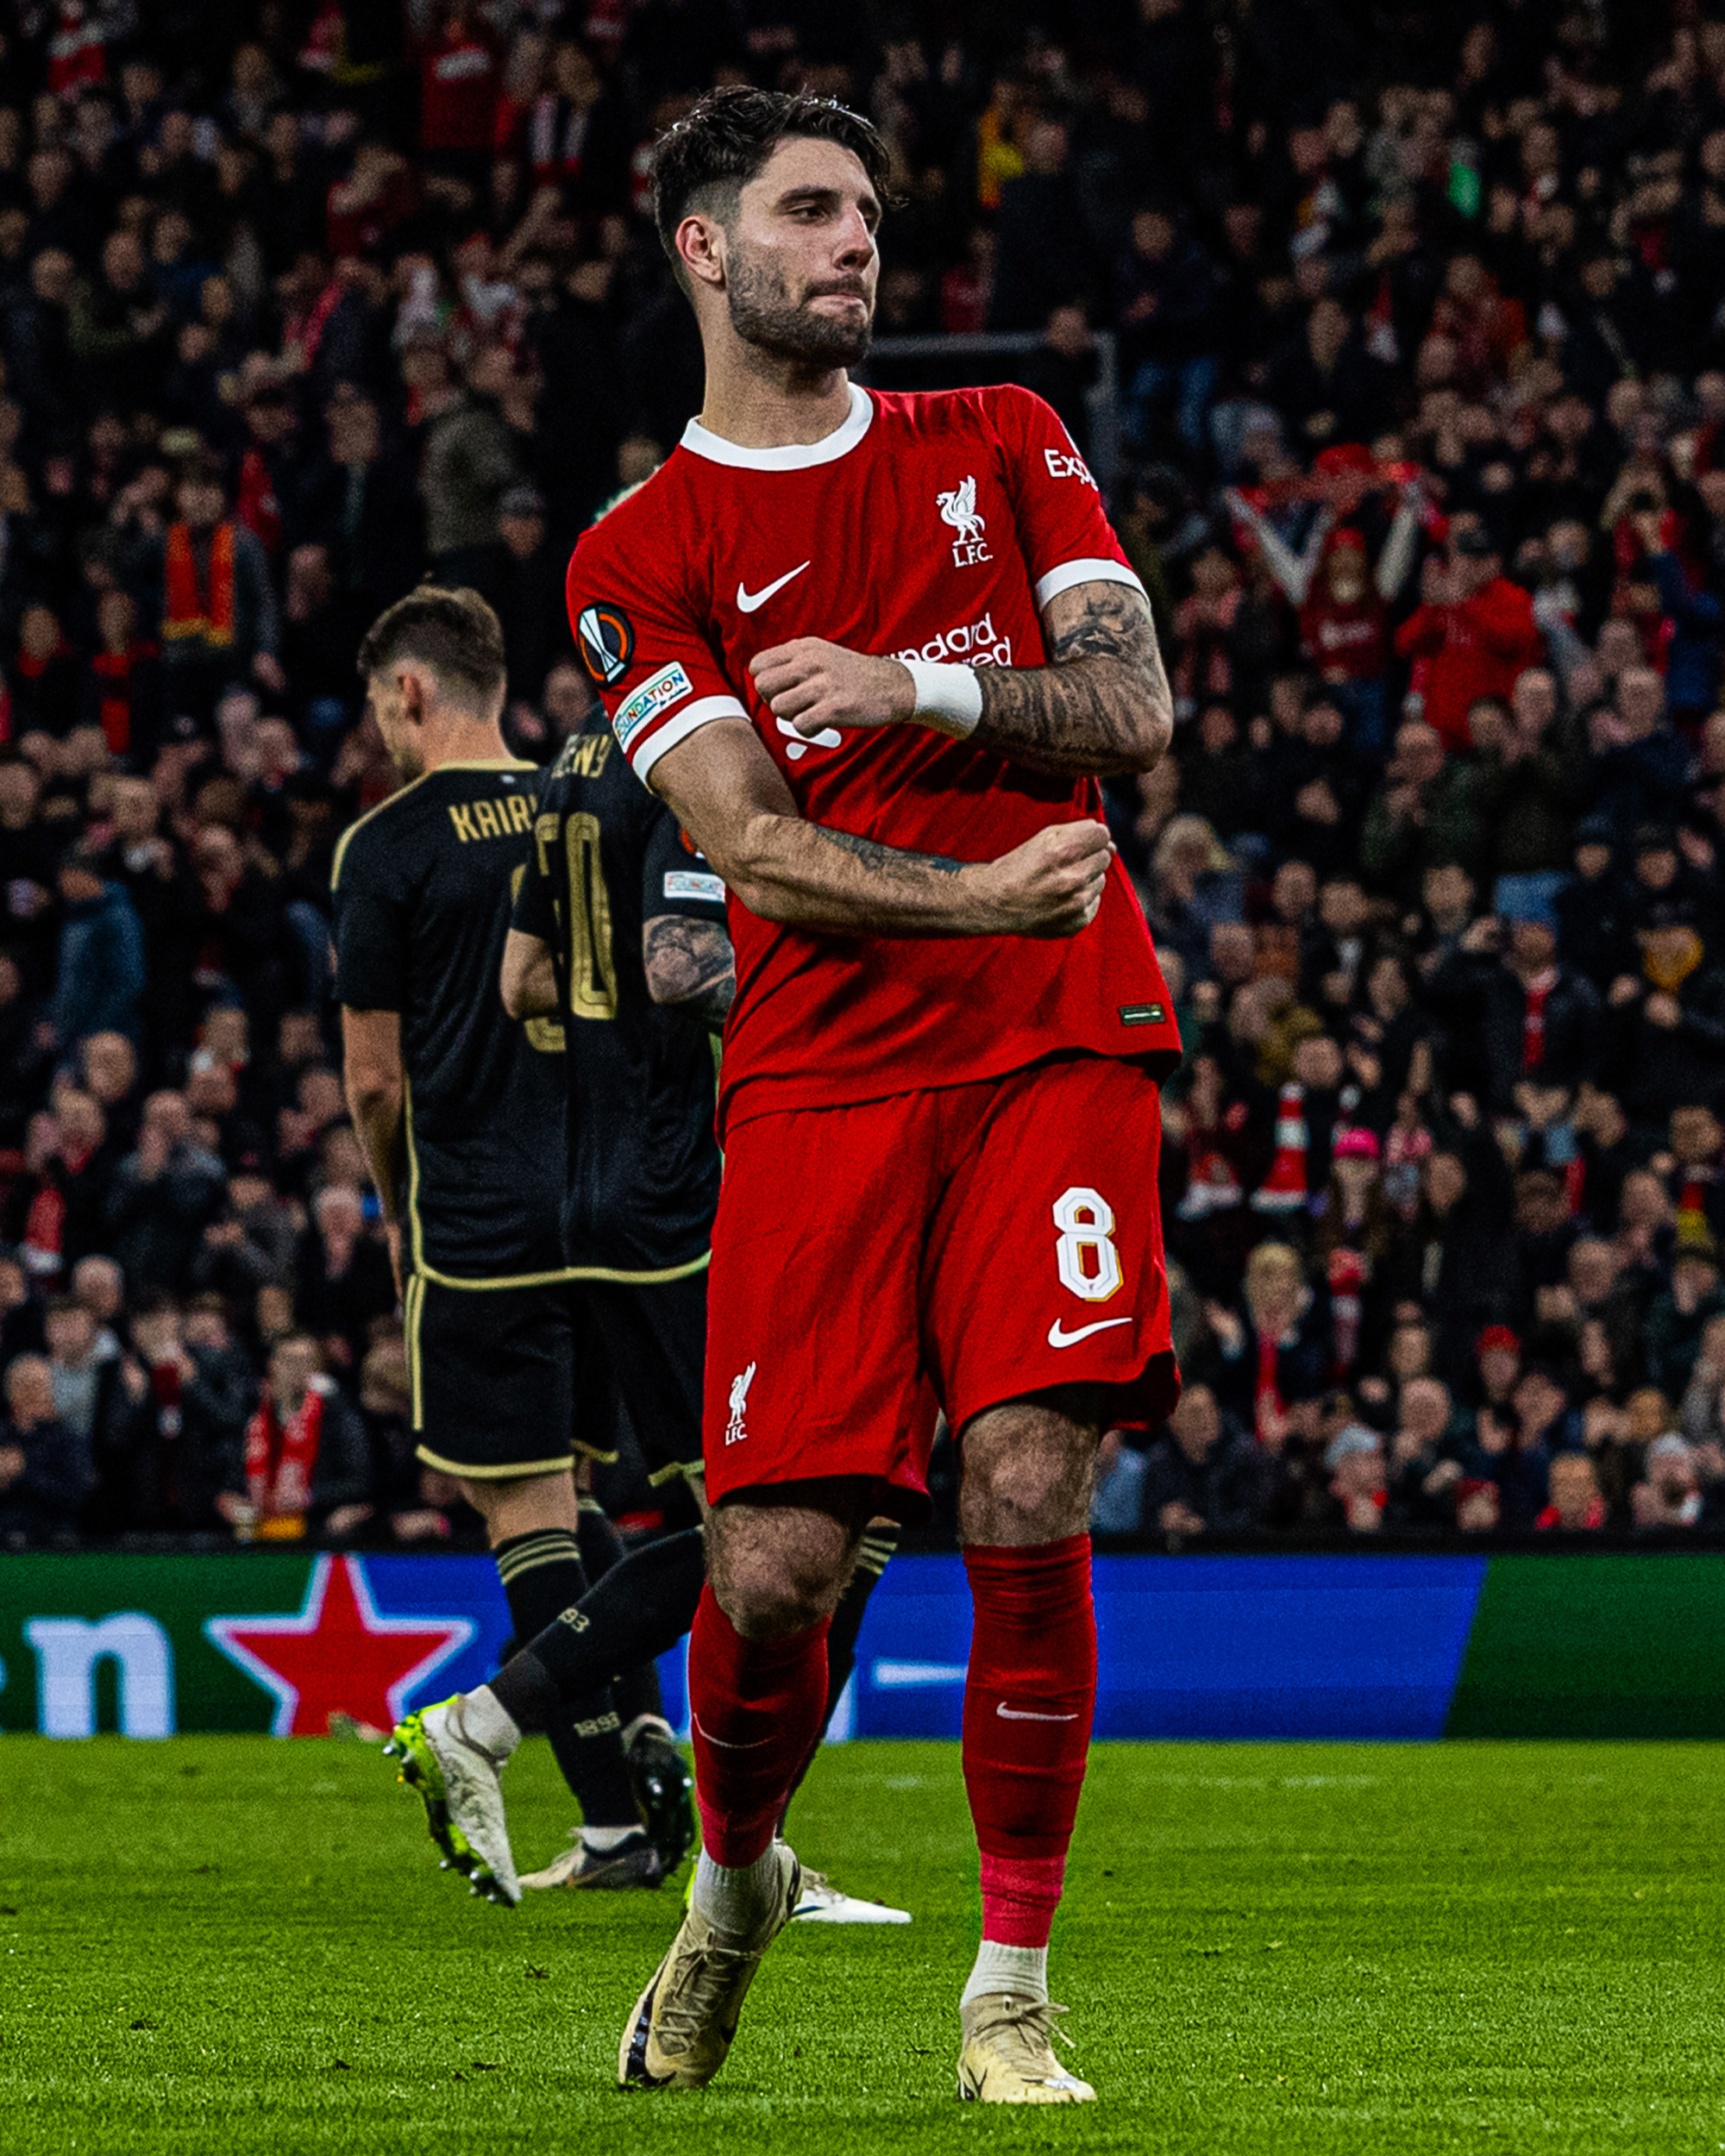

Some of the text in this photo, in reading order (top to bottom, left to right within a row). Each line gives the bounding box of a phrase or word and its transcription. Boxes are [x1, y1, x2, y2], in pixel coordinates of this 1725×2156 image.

[1044, 448, 1099, 492] Exp
[890, 611, 998, 663] ndard
[1052, 1187, 1124, 1302] 8
[557, 1608, 590, 1633] 93
[574, 1711, 620, 1738] 1893
